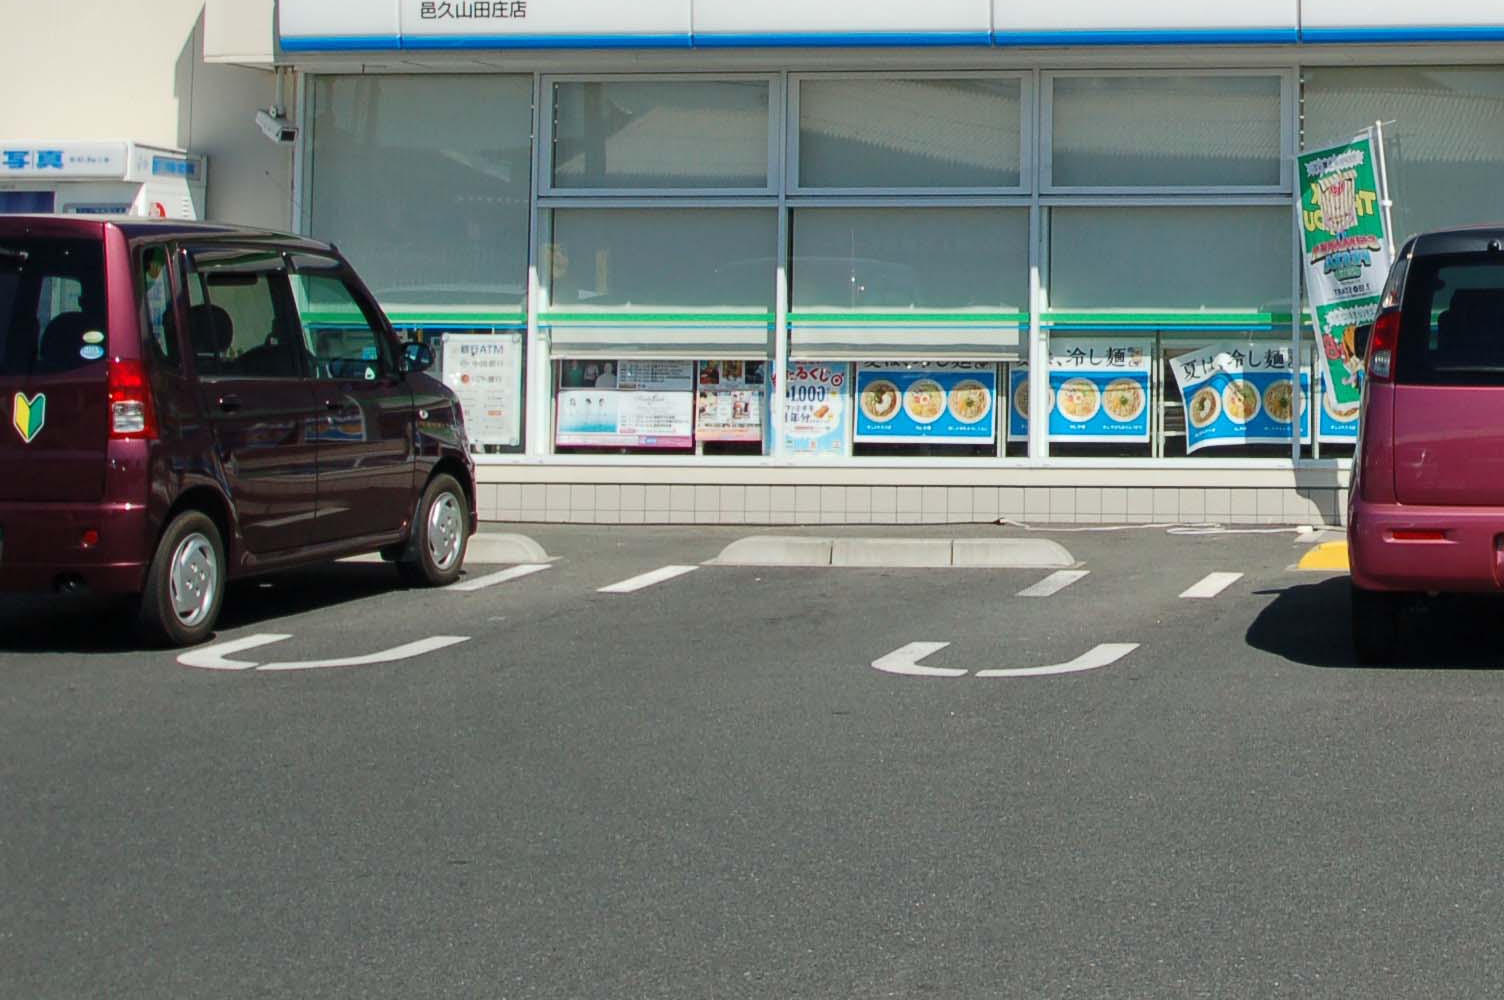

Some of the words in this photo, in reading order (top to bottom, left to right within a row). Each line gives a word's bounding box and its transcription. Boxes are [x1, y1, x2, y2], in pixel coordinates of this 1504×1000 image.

[420, 0, 527, 19] 邑久山田庄店
